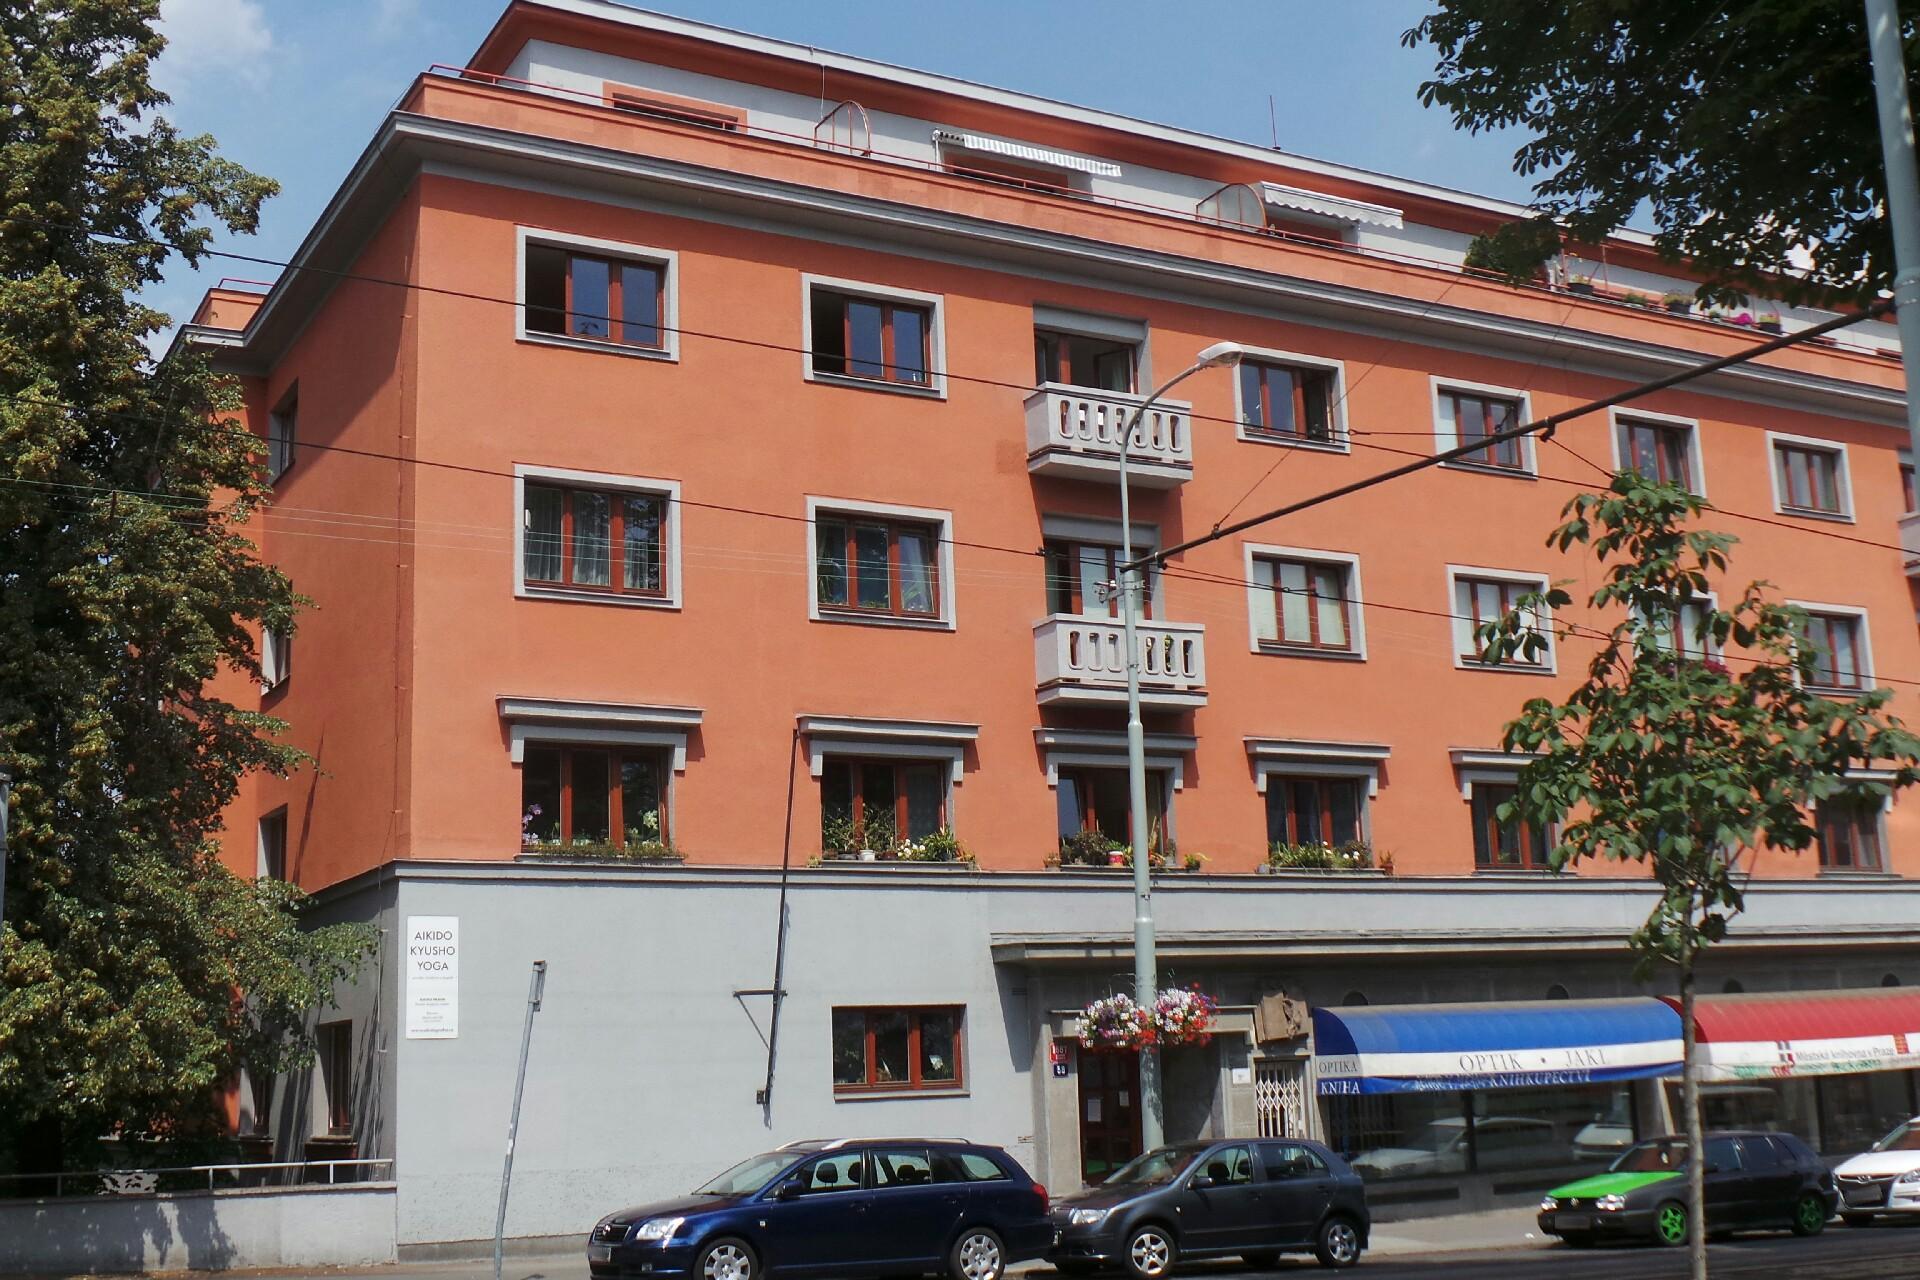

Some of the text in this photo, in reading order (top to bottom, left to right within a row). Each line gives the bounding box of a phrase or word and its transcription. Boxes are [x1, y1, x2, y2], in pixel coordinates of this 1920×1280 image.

[414, 931, 453, 941] AIKIDO
[410, 946, 456, 956] KYUSHO
[417, 961, 449, 971] YOGA
[1319, 1061, 1358, 1073] OPTIKA
[1459, 1053, 1523, 1072] OPTIK
[1320, 1080, 1361, 1096] KNIHA
